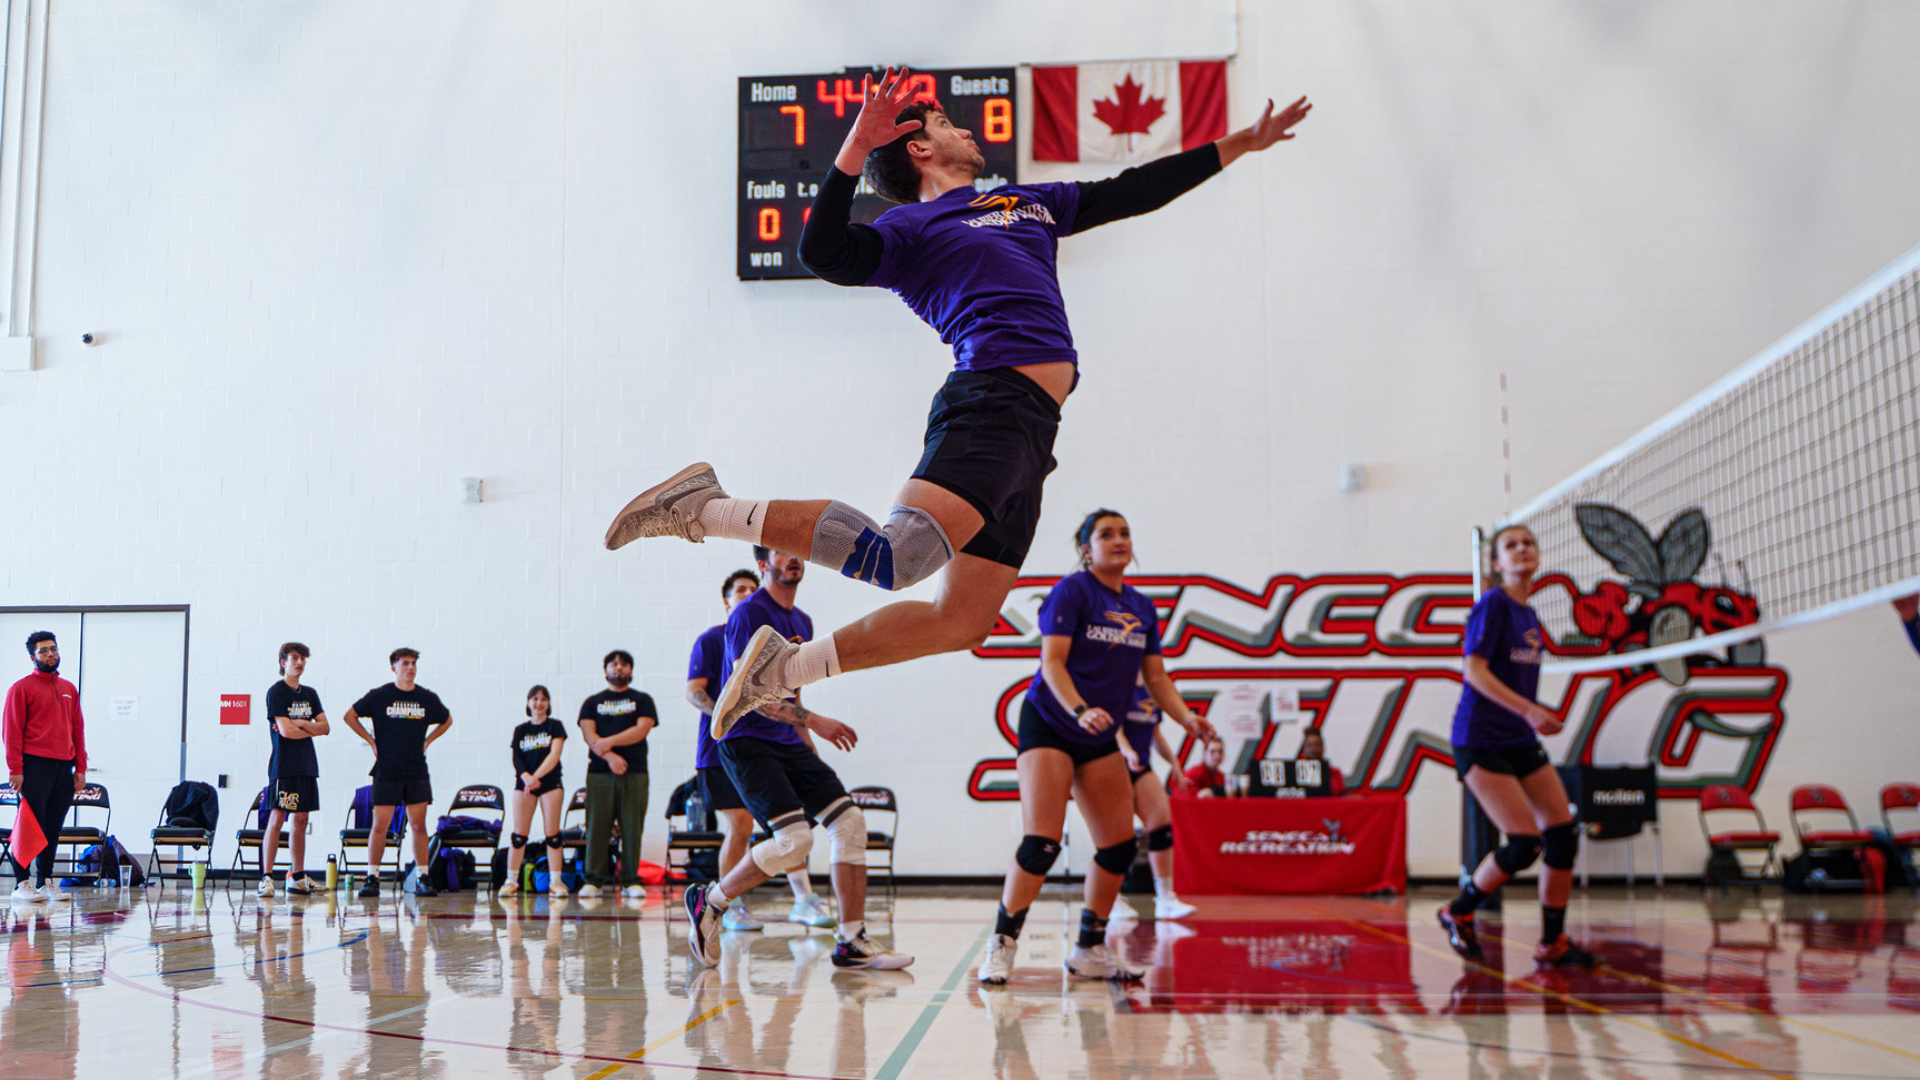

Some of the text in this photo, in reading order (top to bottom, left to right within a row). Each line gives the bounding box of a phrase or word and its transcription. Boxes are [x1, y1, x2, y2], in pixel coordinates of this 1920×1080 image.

[751, 82, 797, 102] Home
[950, 75, 1010, 96] Guests
[779, 105, 805, 146] 7
[983, 98, 1012, 143] 8
[746, 180, 786, 199] fouls
[758, 207, 781, 242] 0
[750, 251, 783, 267] won
[386, 706, 426, 717] CHAMPIONS
[1245, 830, 1331, 842] SENECA
[1220, 842, 1356, 855] RECREATION
